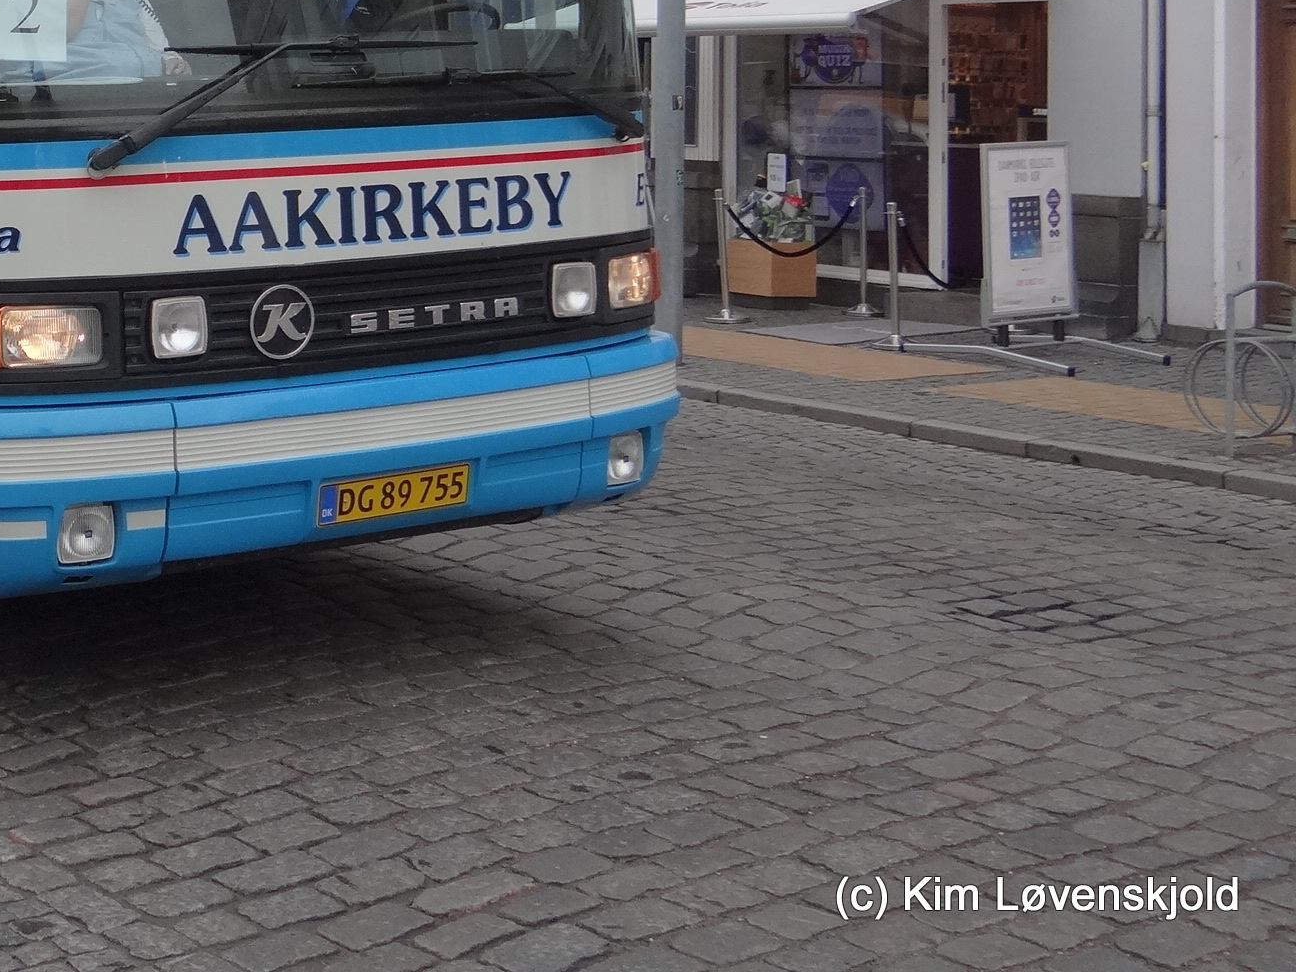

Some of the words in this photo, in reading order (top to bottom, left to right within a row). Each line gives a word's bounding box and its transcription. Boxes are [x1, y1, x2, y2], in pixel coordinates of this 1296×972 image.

[818, 54, 852, 68] QUIZ
[172, 171, 571, 257] AAKIRKEBY
[350, 296, 519, 334] SETRA
[338, 484, 375, 516] DG
[380, 479, 412, 510] 89
[419, 471, 464, 504] 755
[321, 508, 333, 518] DK
